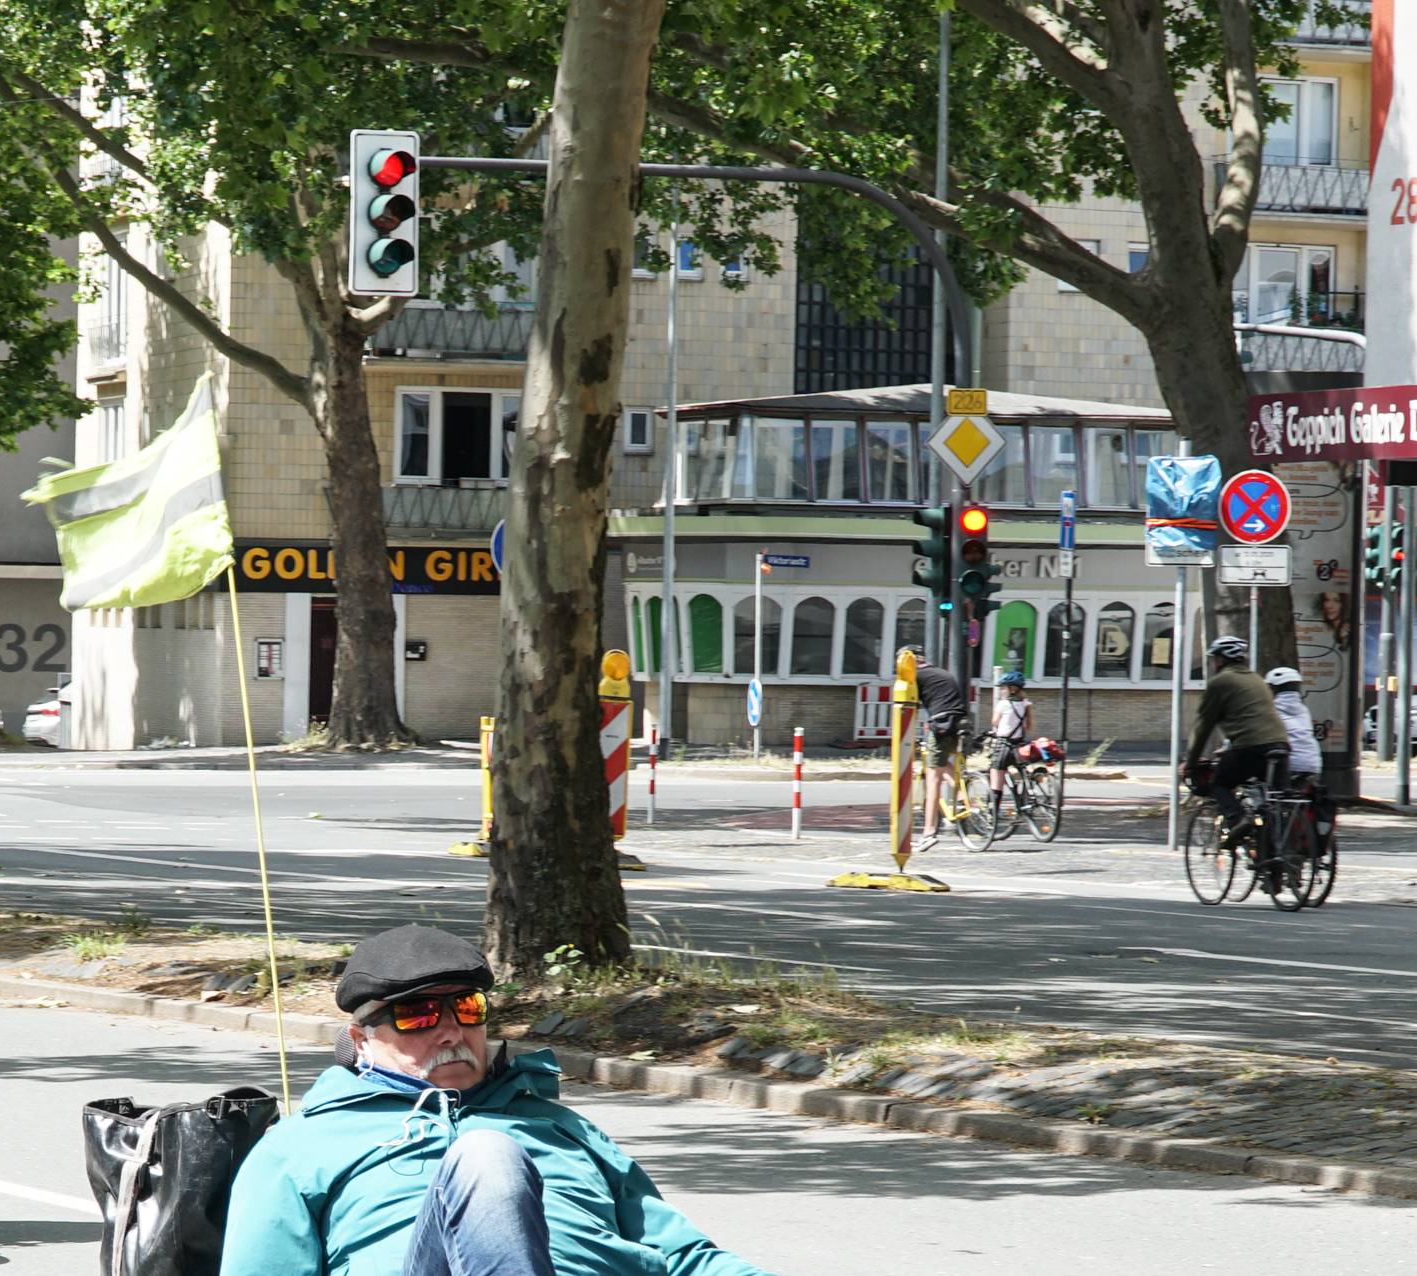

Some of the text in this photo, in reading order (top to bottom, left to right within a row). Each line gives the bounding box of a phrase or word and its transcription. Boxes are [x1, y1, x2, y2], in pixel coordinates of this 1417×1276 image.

[953, 393, 983, 410] 226
[1350, 401, 1405, 444] Galerie
[242, 547, 499, 582] GOLN GIR
